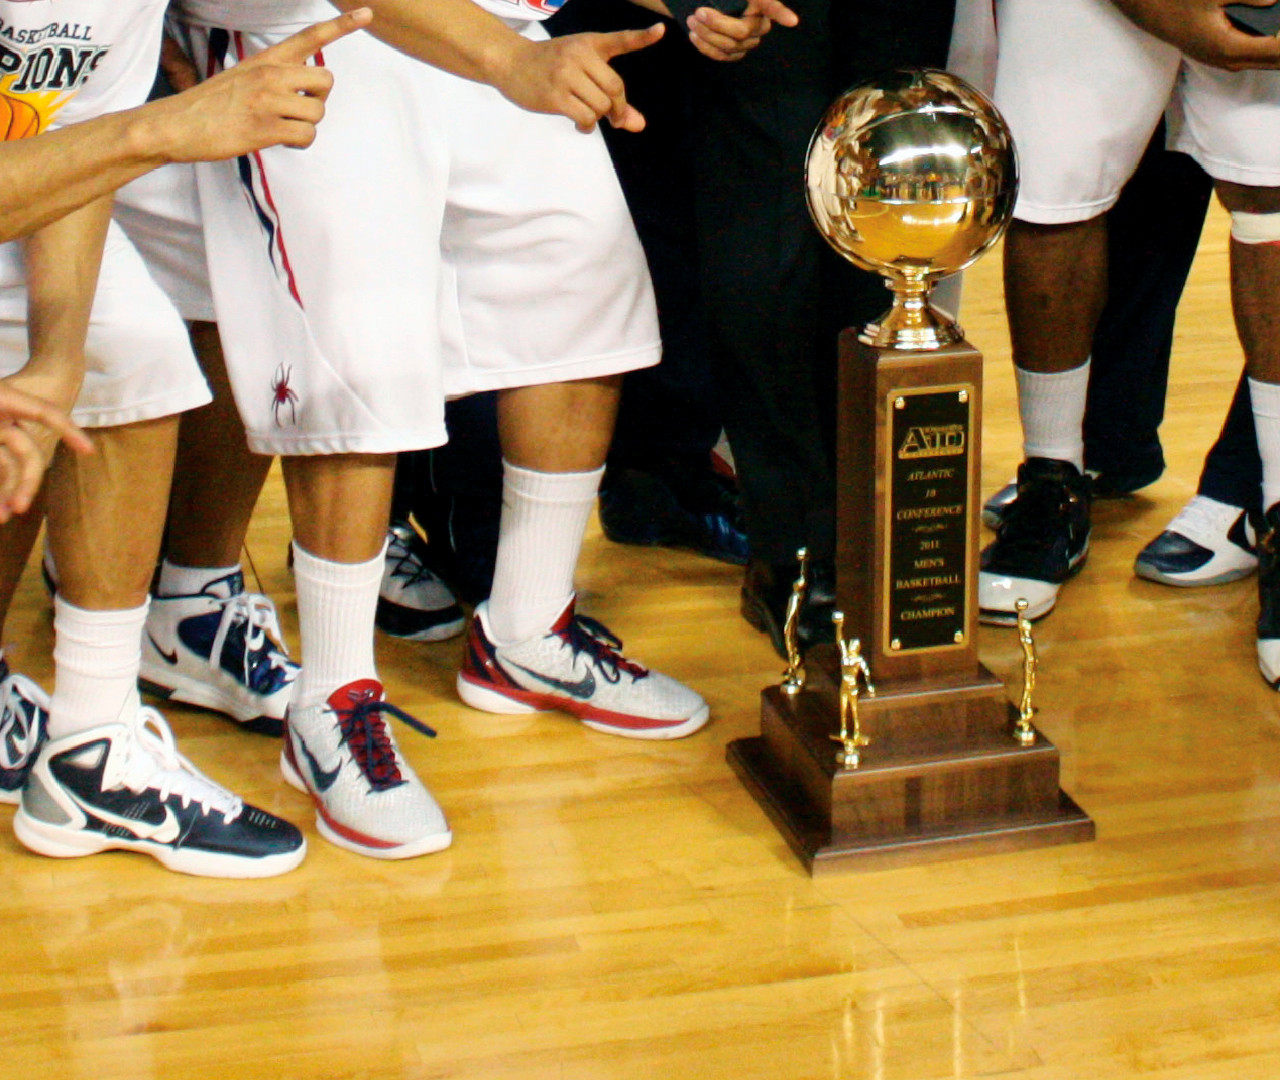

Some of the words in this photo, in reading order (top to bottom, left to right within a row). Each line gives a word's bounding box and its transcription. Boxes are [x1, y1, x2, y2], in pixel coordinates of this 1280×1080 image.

[907, 470, 954, 482] ATLANTIC
[896, 505, 962, 521] CONFERENCE
[921, 540, 940, 551] 2011
[914, 558, 945, 570] MEN'S
[895, 575, 961, 590] BASKETBALL
[900, 607, 955, 621] CHAMPION
